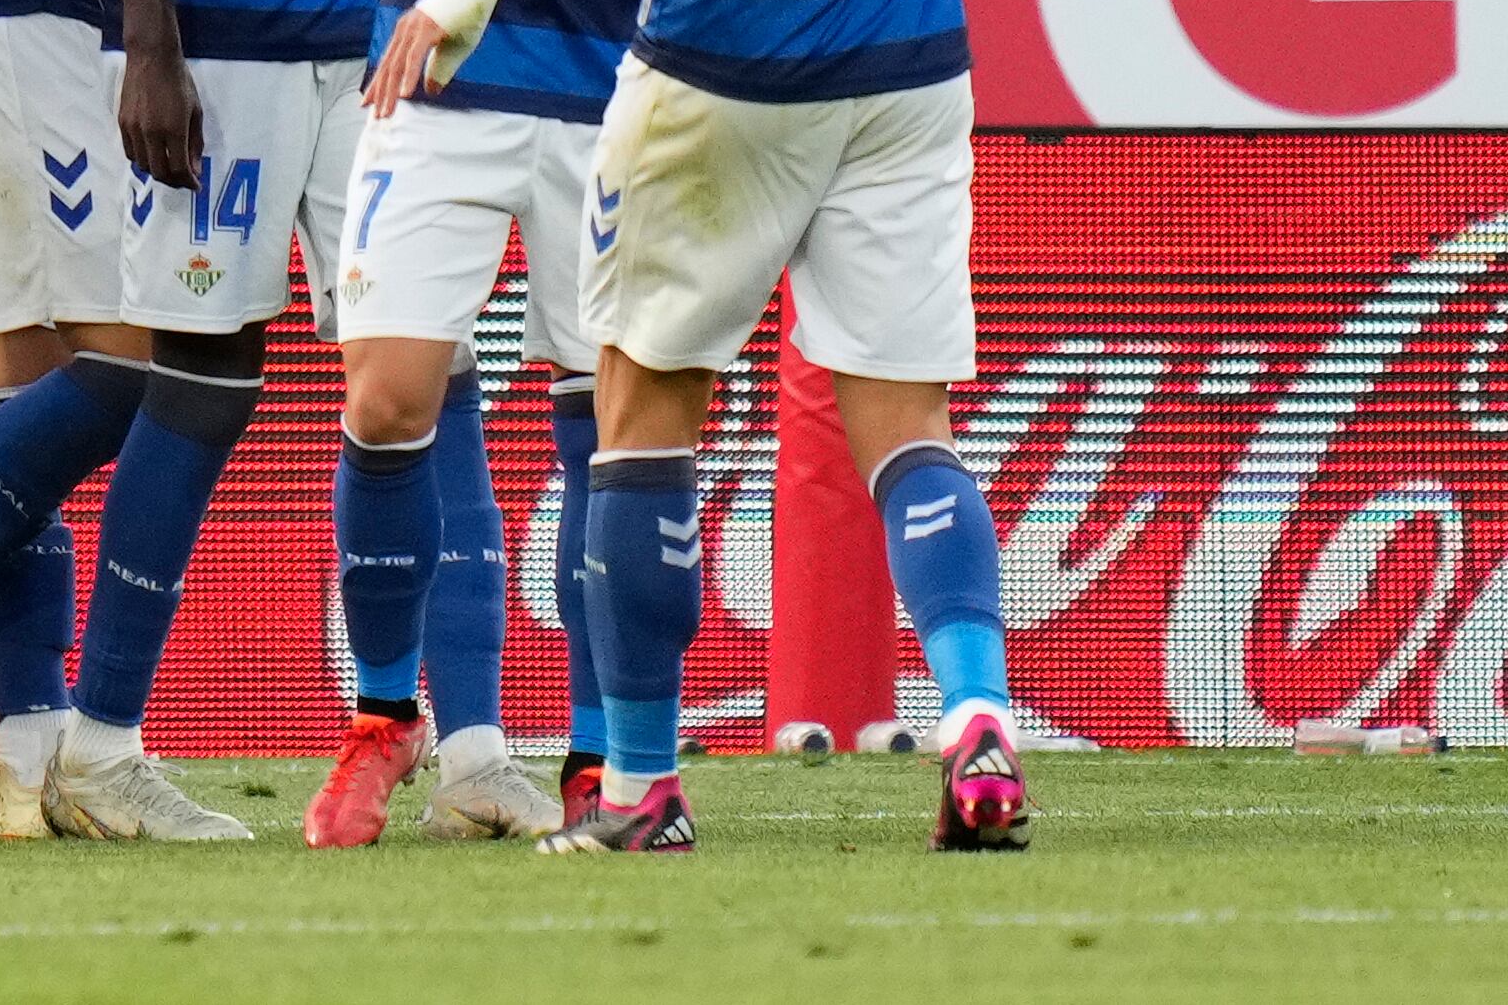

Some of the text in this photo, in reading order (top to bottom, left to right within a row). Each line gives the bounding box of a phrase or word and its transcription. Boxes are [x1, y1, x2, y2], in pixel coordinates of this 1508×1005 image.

[189, 156, 262, 246] 14
[353, 169, 394, 254] 7
[108, 560, 165, 593] REAL
